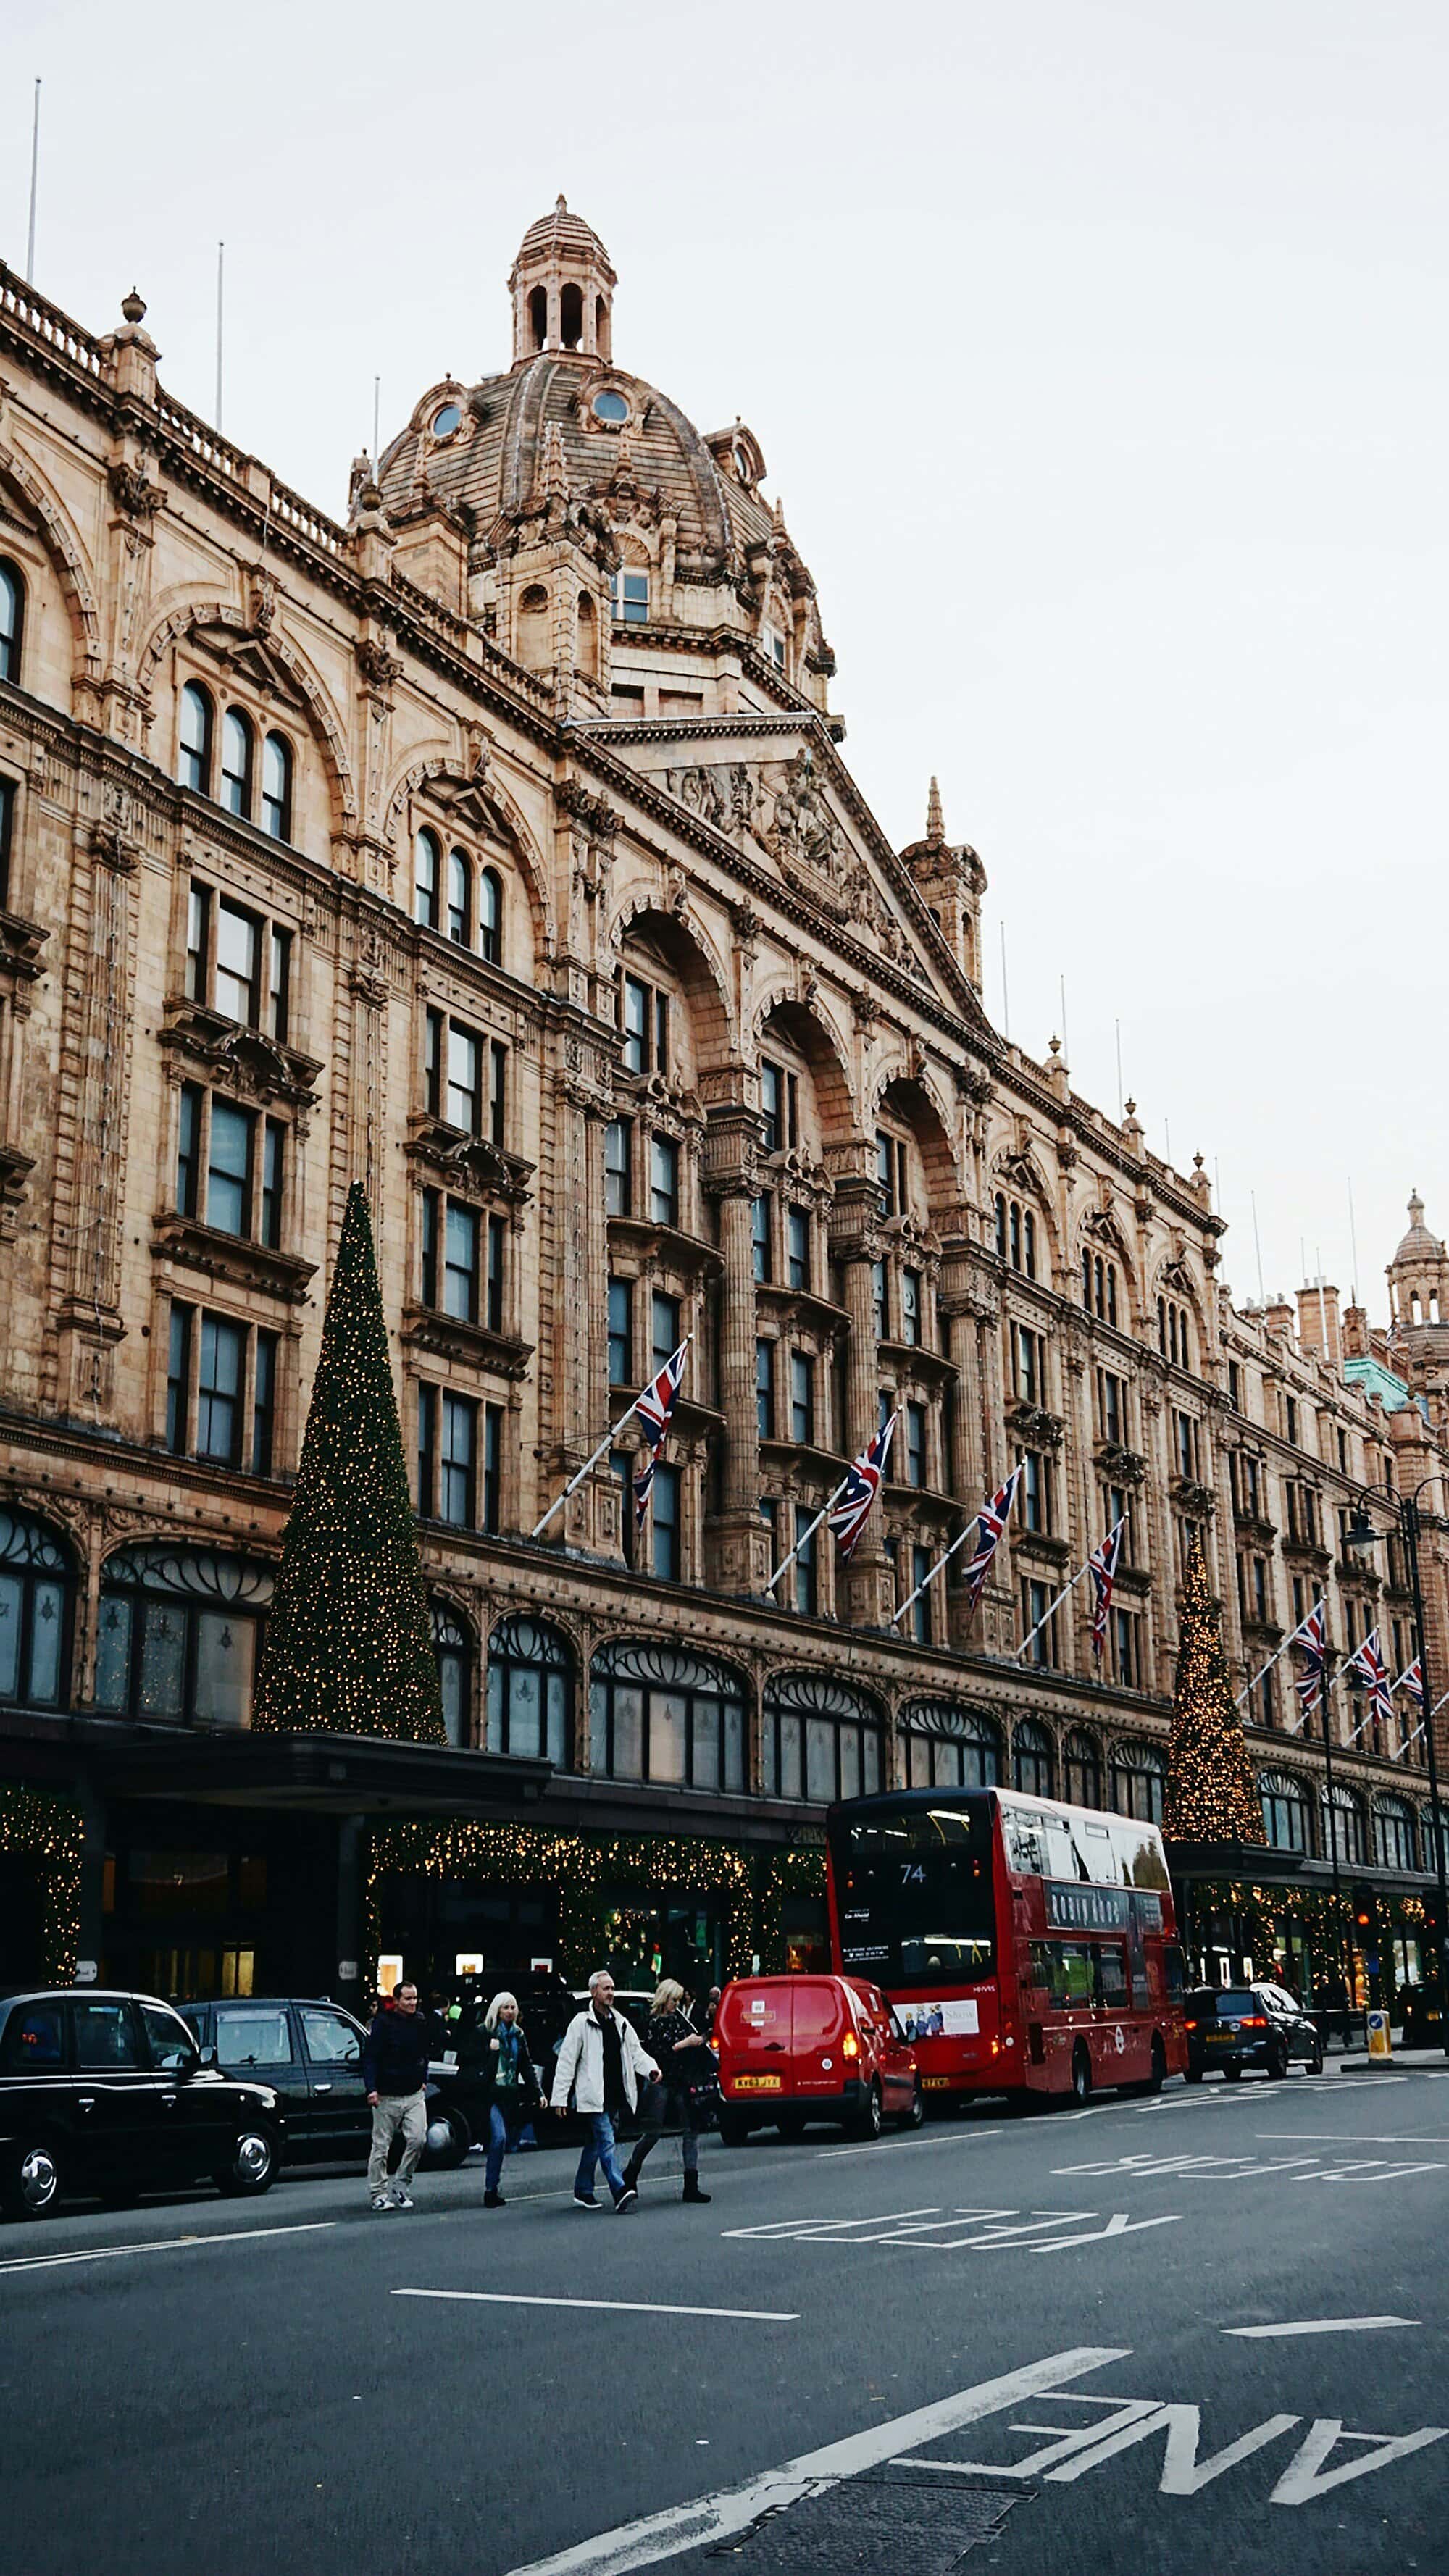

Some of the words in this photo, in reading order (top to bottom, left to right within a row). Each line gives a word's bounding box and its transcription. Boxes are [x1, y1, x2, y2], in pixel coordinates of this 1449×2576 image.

[900, 1864, 927, 1883] 74
[1051, 2153, 1448, 2182] CLEAR
[720, 2207, 1183, 2253] KEEP
[888, 2392, 1449, 2506] ANE
